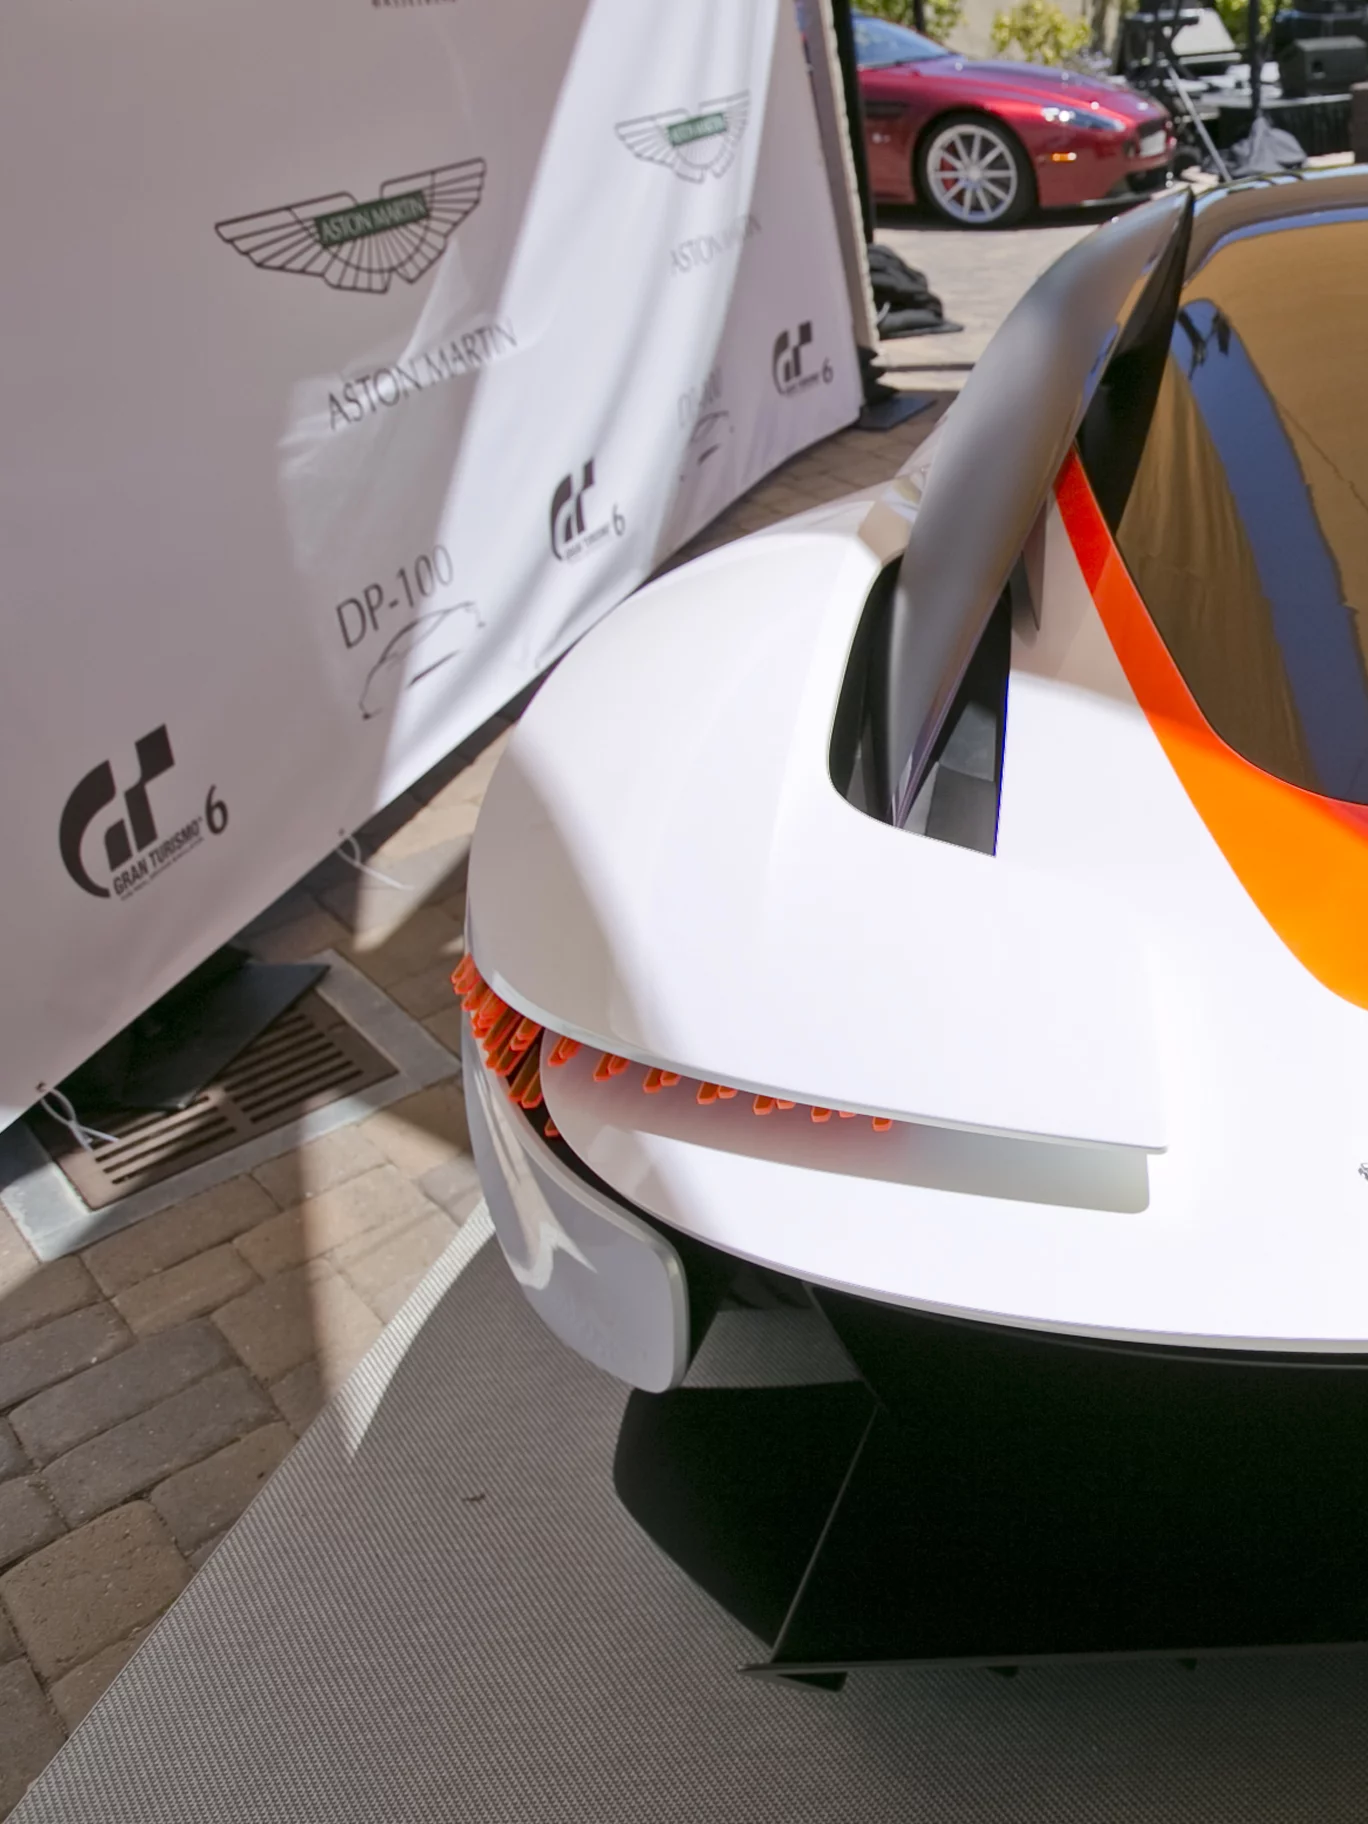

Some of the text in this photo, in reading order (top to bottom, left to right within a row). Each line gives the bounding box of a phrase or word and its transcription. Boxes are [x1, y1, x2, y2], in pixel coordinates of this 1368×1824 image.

[321, 194, 427, 243] ASTON MARTIN
[328, 322, 517, 430] ASTON MARTIN
[822, 356, 834, 384] 6
[612, 502, 626, 537] 6
[336, 545, 454, 649] DP-100
[113, 858, 148, 896] GRAN
[205, 784, 228, 836] 6
